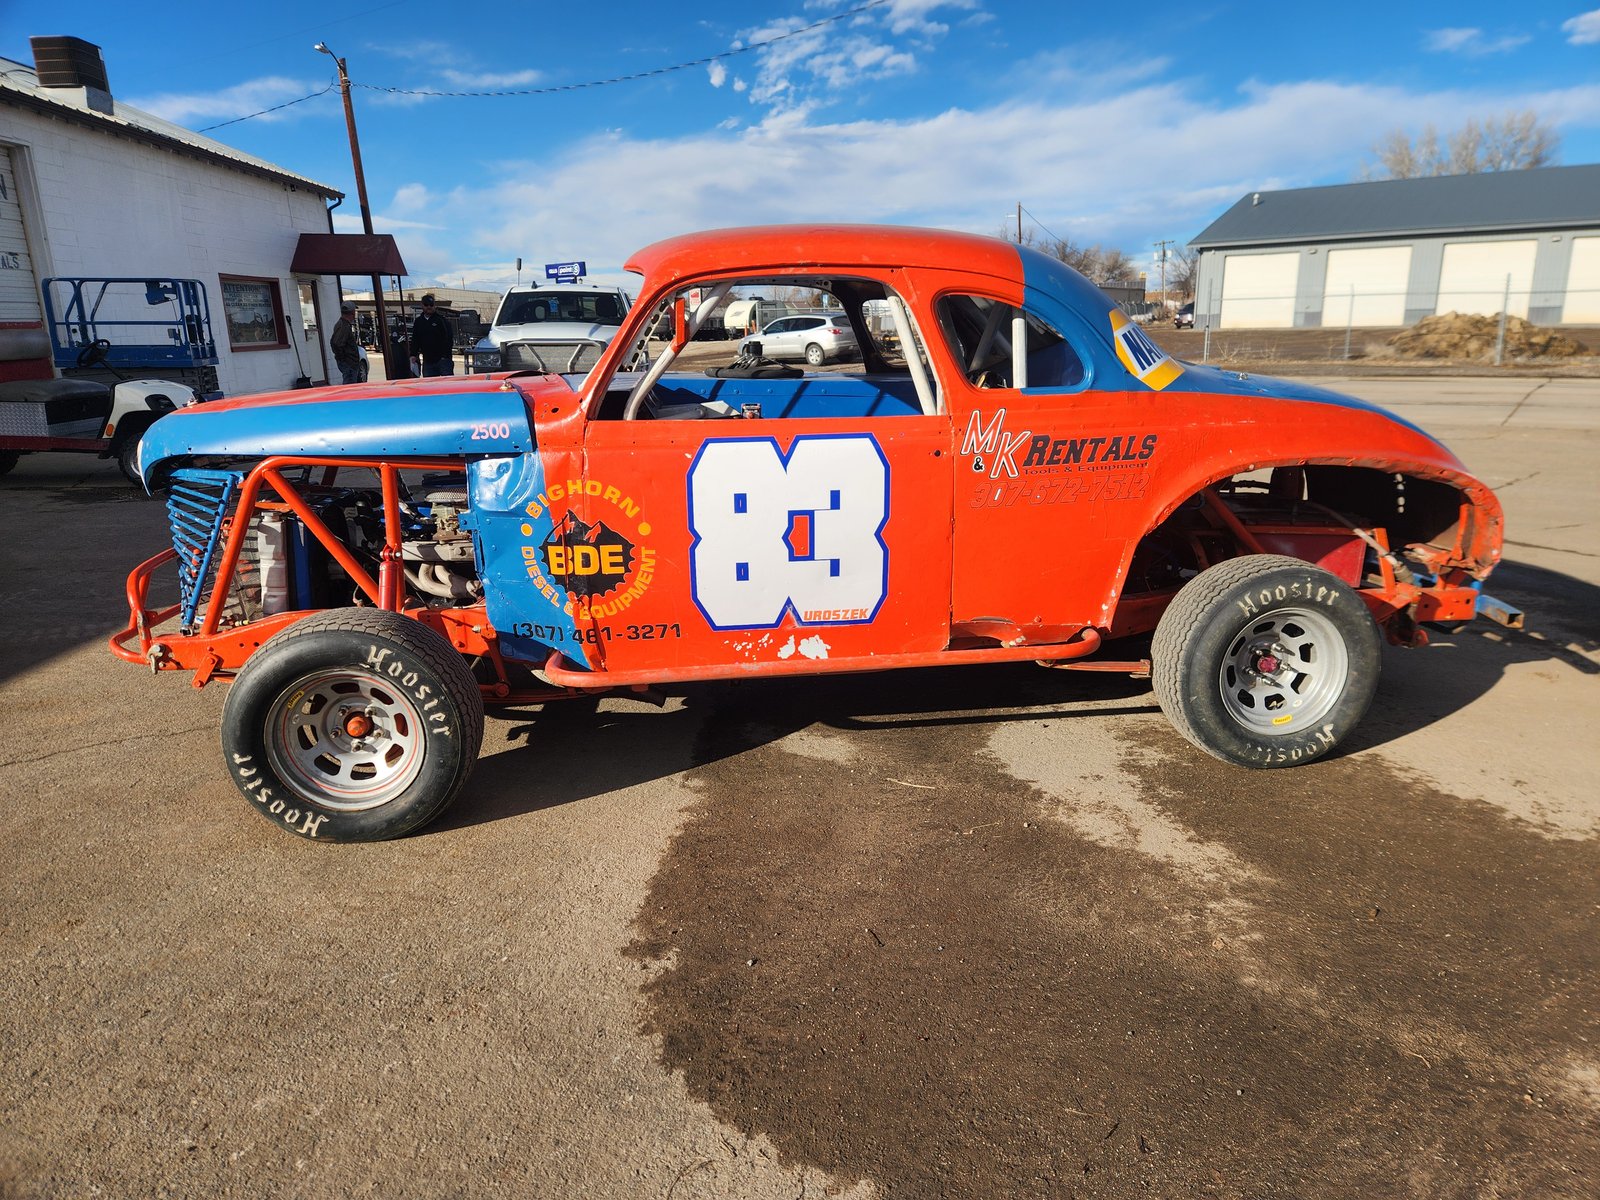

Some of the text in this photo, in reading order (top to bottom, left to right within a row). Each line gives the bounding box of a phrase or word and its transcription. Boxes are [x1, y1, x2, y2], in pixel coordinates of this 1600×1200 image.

[470, 423, 510, 440] 2500
[973, 456, 986, 472] &
[1024, 461, 1149, 476] Tools & Equipment
[525, 479, 641, 519] BIGHORN
[685, 432, 892, 632] 83
[547, 544, 625, 576] BDE
[521, 546, 656, 620] DIESEL & EQUIPMENT
[1237, 577, 1340, 617] Hoosier
[803, 607, 869, 621] UROSZEK
[513, 622, 564, 643] (307)
[359, 644, 451, 737] Hoosier
[232, 752, 330, 838] Hoosier
